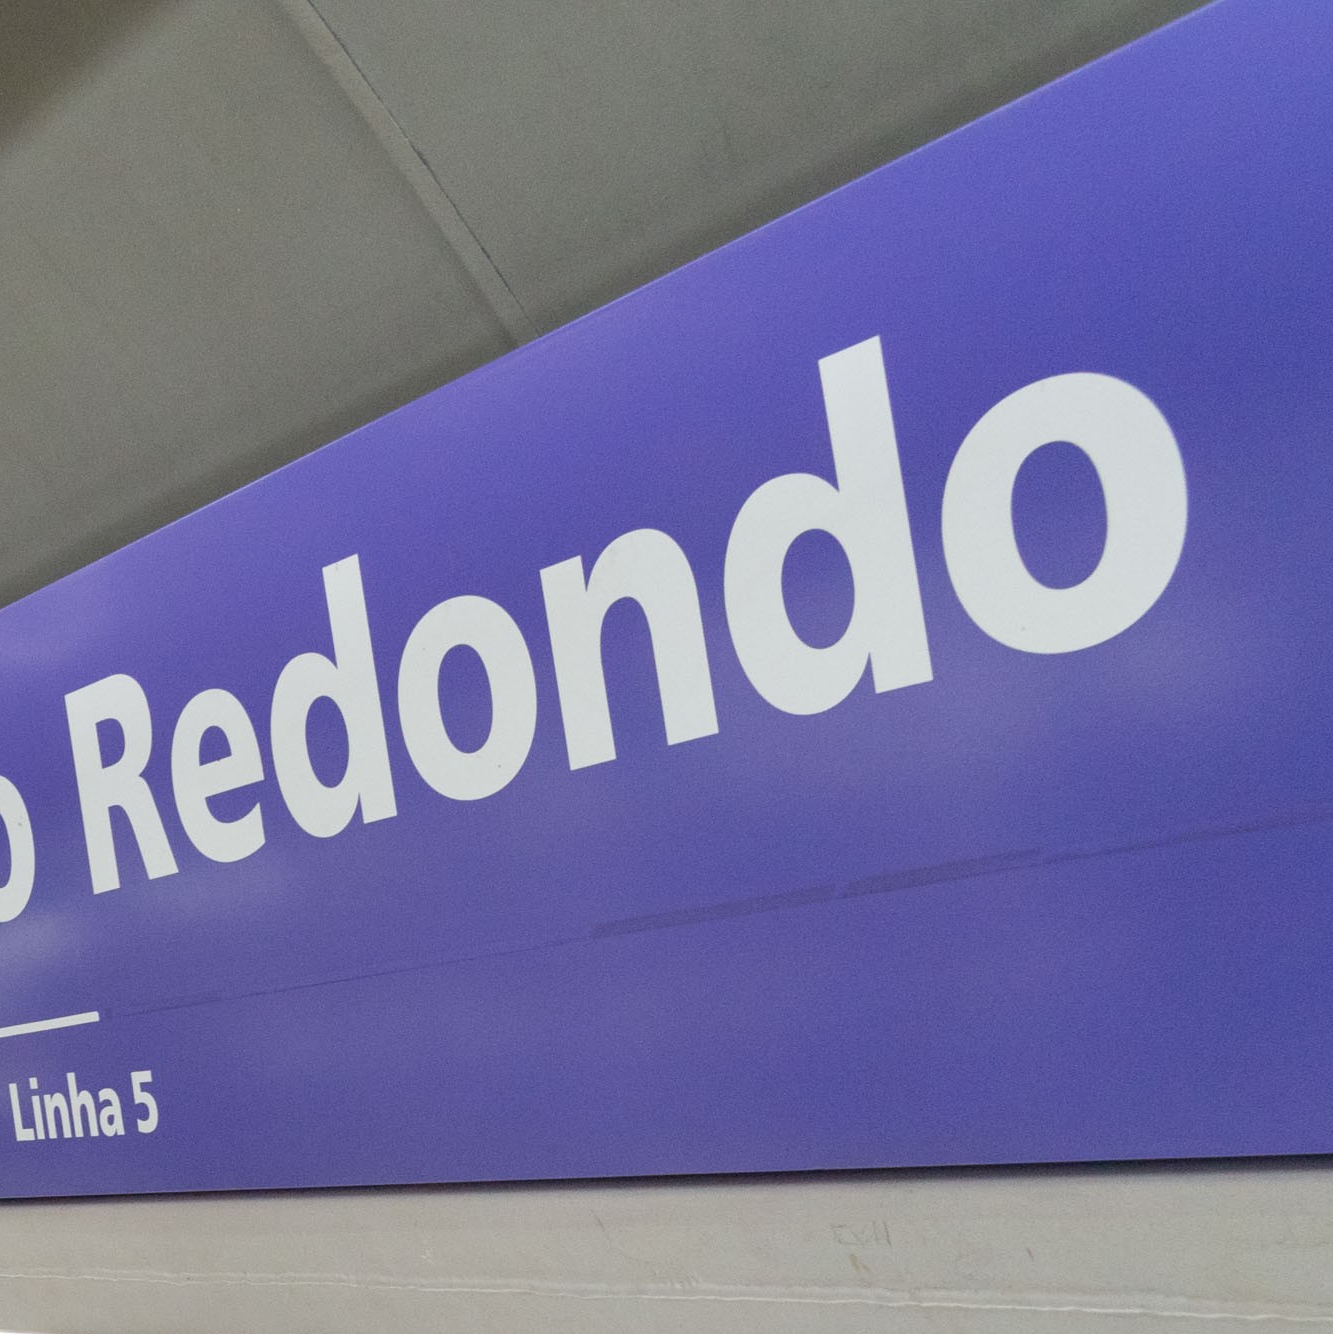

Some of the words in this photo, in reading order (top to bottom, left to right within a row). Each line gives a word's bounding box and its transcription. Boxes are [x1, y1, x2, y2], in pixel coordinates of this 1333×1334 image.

[64, 335, 1188, 893] Redondo
[9, 1073, 126, 1142] Linha
[134, 1070, 159, 1133] 5
